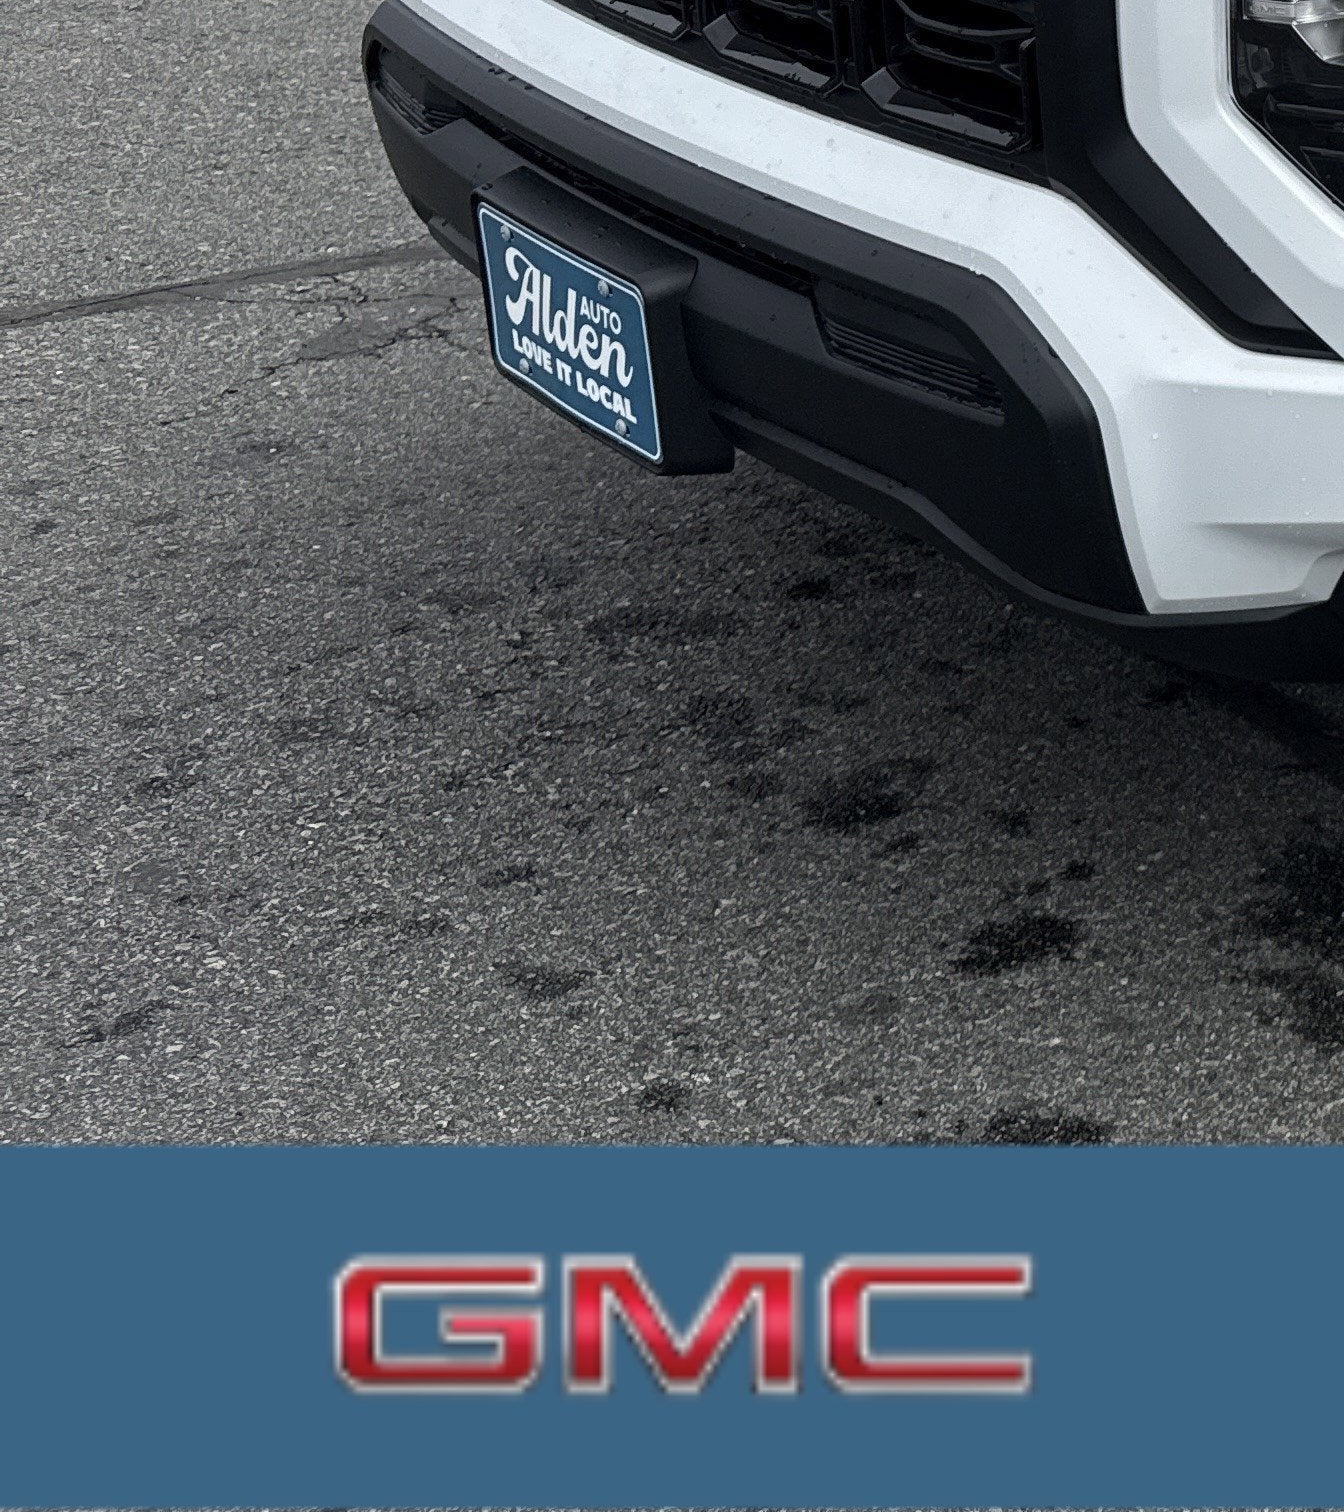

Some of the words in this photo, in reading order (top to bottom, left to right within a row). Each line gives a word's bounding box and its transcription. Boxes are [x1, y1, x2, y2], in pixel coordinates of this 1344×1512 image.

[505, 246, 634, 388] Alden
[580, 296, 622, 335] AUTO
[512, 328, 553, 375] LOVE
[556, 357, 572, 387] IT
[575, 371, 638, 425] LOCAL
